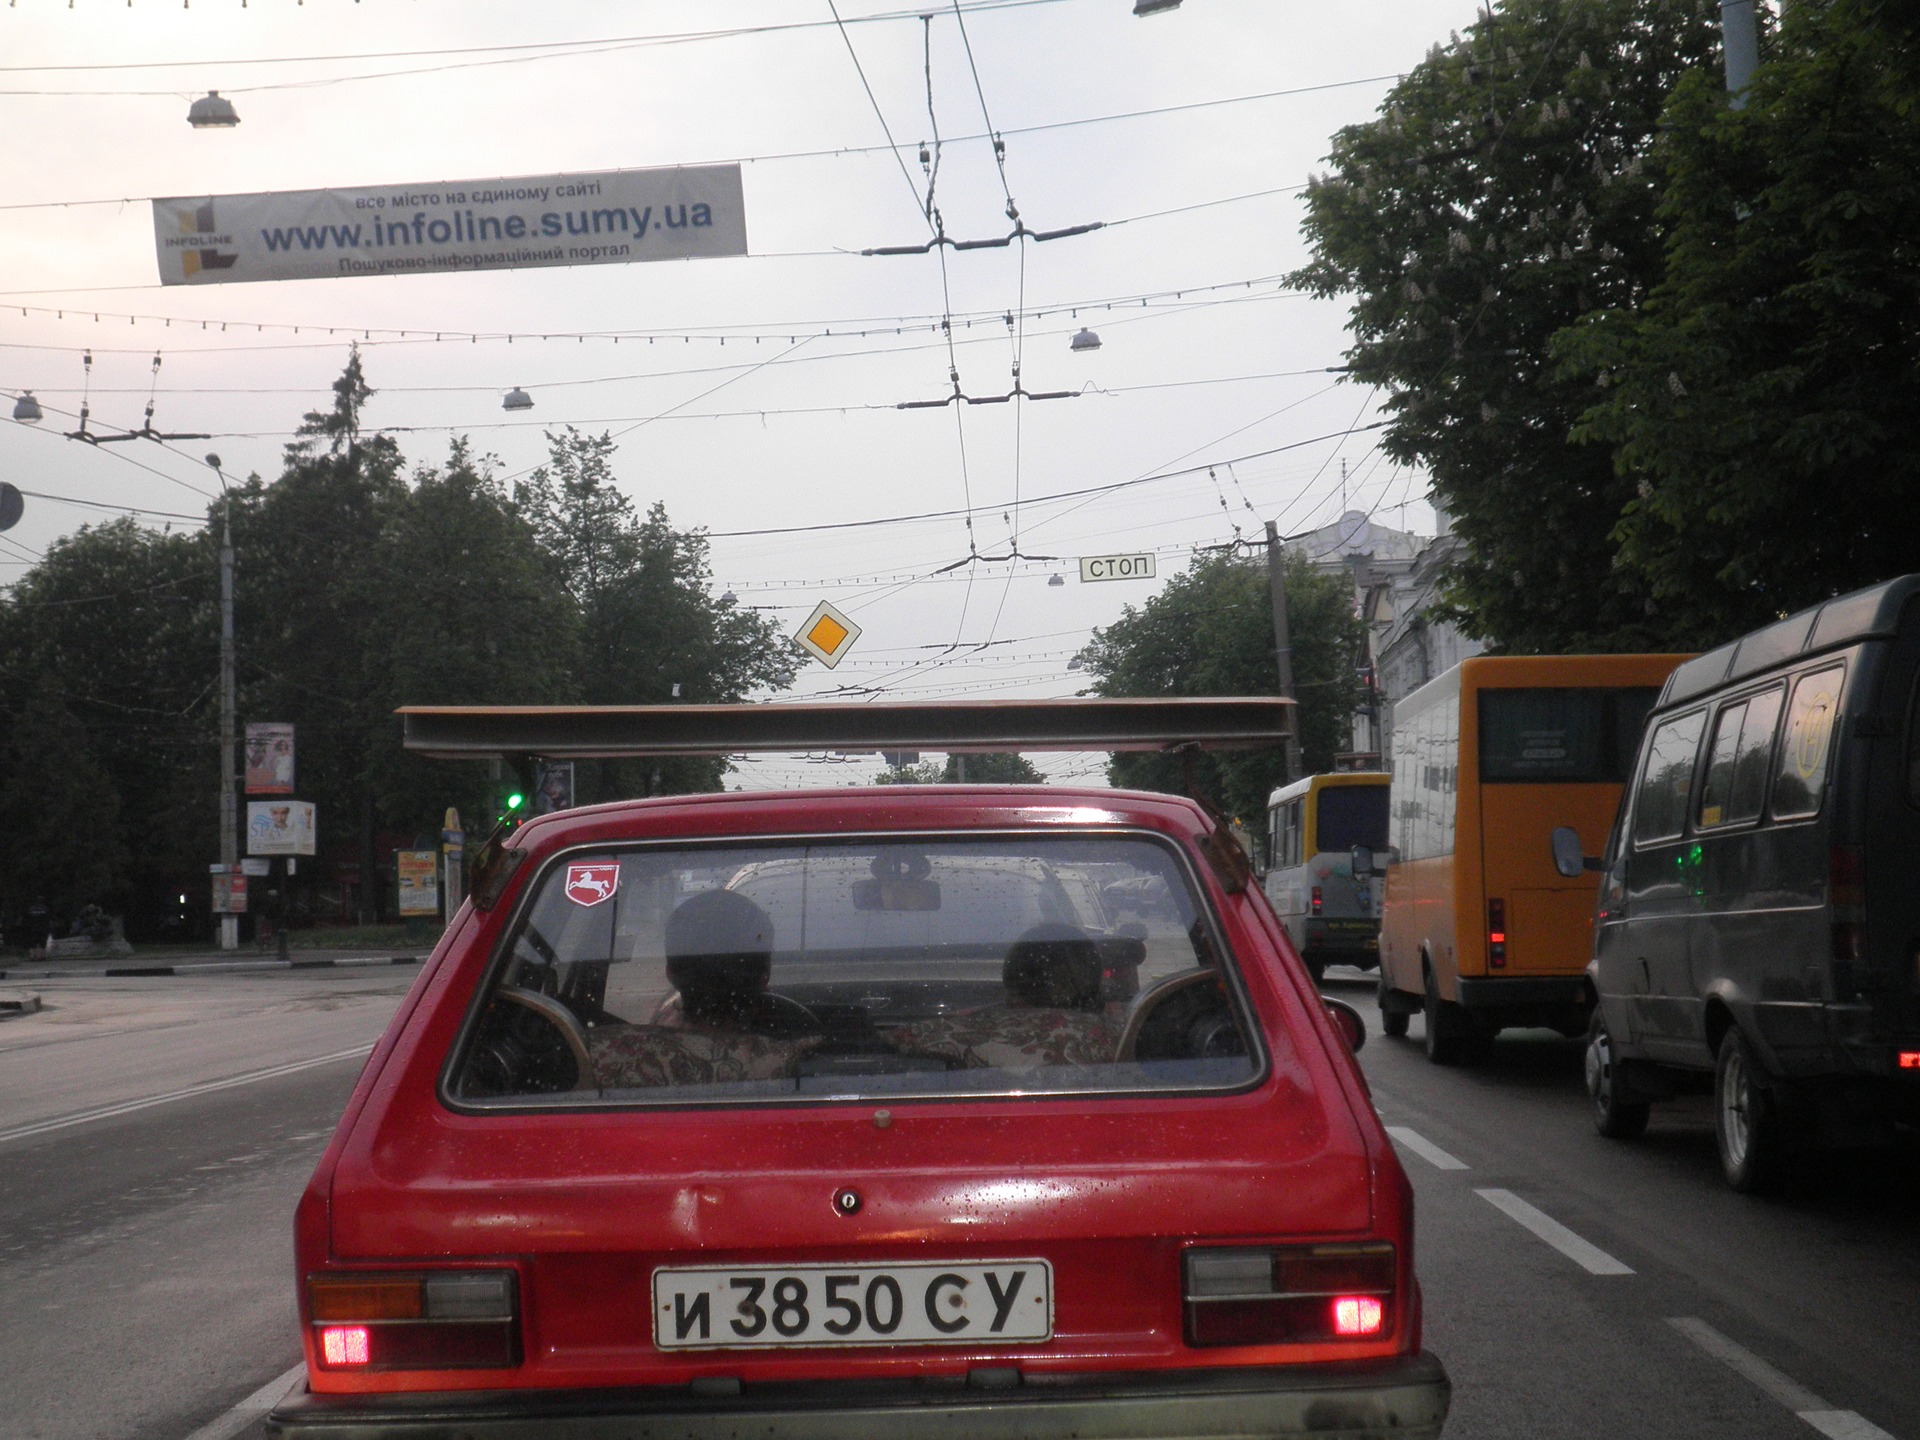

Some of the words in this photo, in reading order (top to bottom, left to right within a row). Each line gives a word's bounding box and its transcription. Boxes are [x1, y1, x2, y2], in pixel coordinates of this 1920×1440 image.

[355, 197, 386, 210] все
[391, 191, 440, 208] місто
[446, 191, 466, 205] на
[471, 187, 550, 204] єдиному
[555, 180, 602, 198] сайті
[165, 234, 233, 248] INFOLINE
[261, 200, 714, 252] www.infoline.sumy.ua
[338, 247, 565, 273] Пошуково-інформаційний
[568, 243, 631, 261] портал
[1090, 557, 1148, 577] СТОП
[729, 1274, 903, 1338] 3850
[924, 1270, 1027, 1334] СУ
